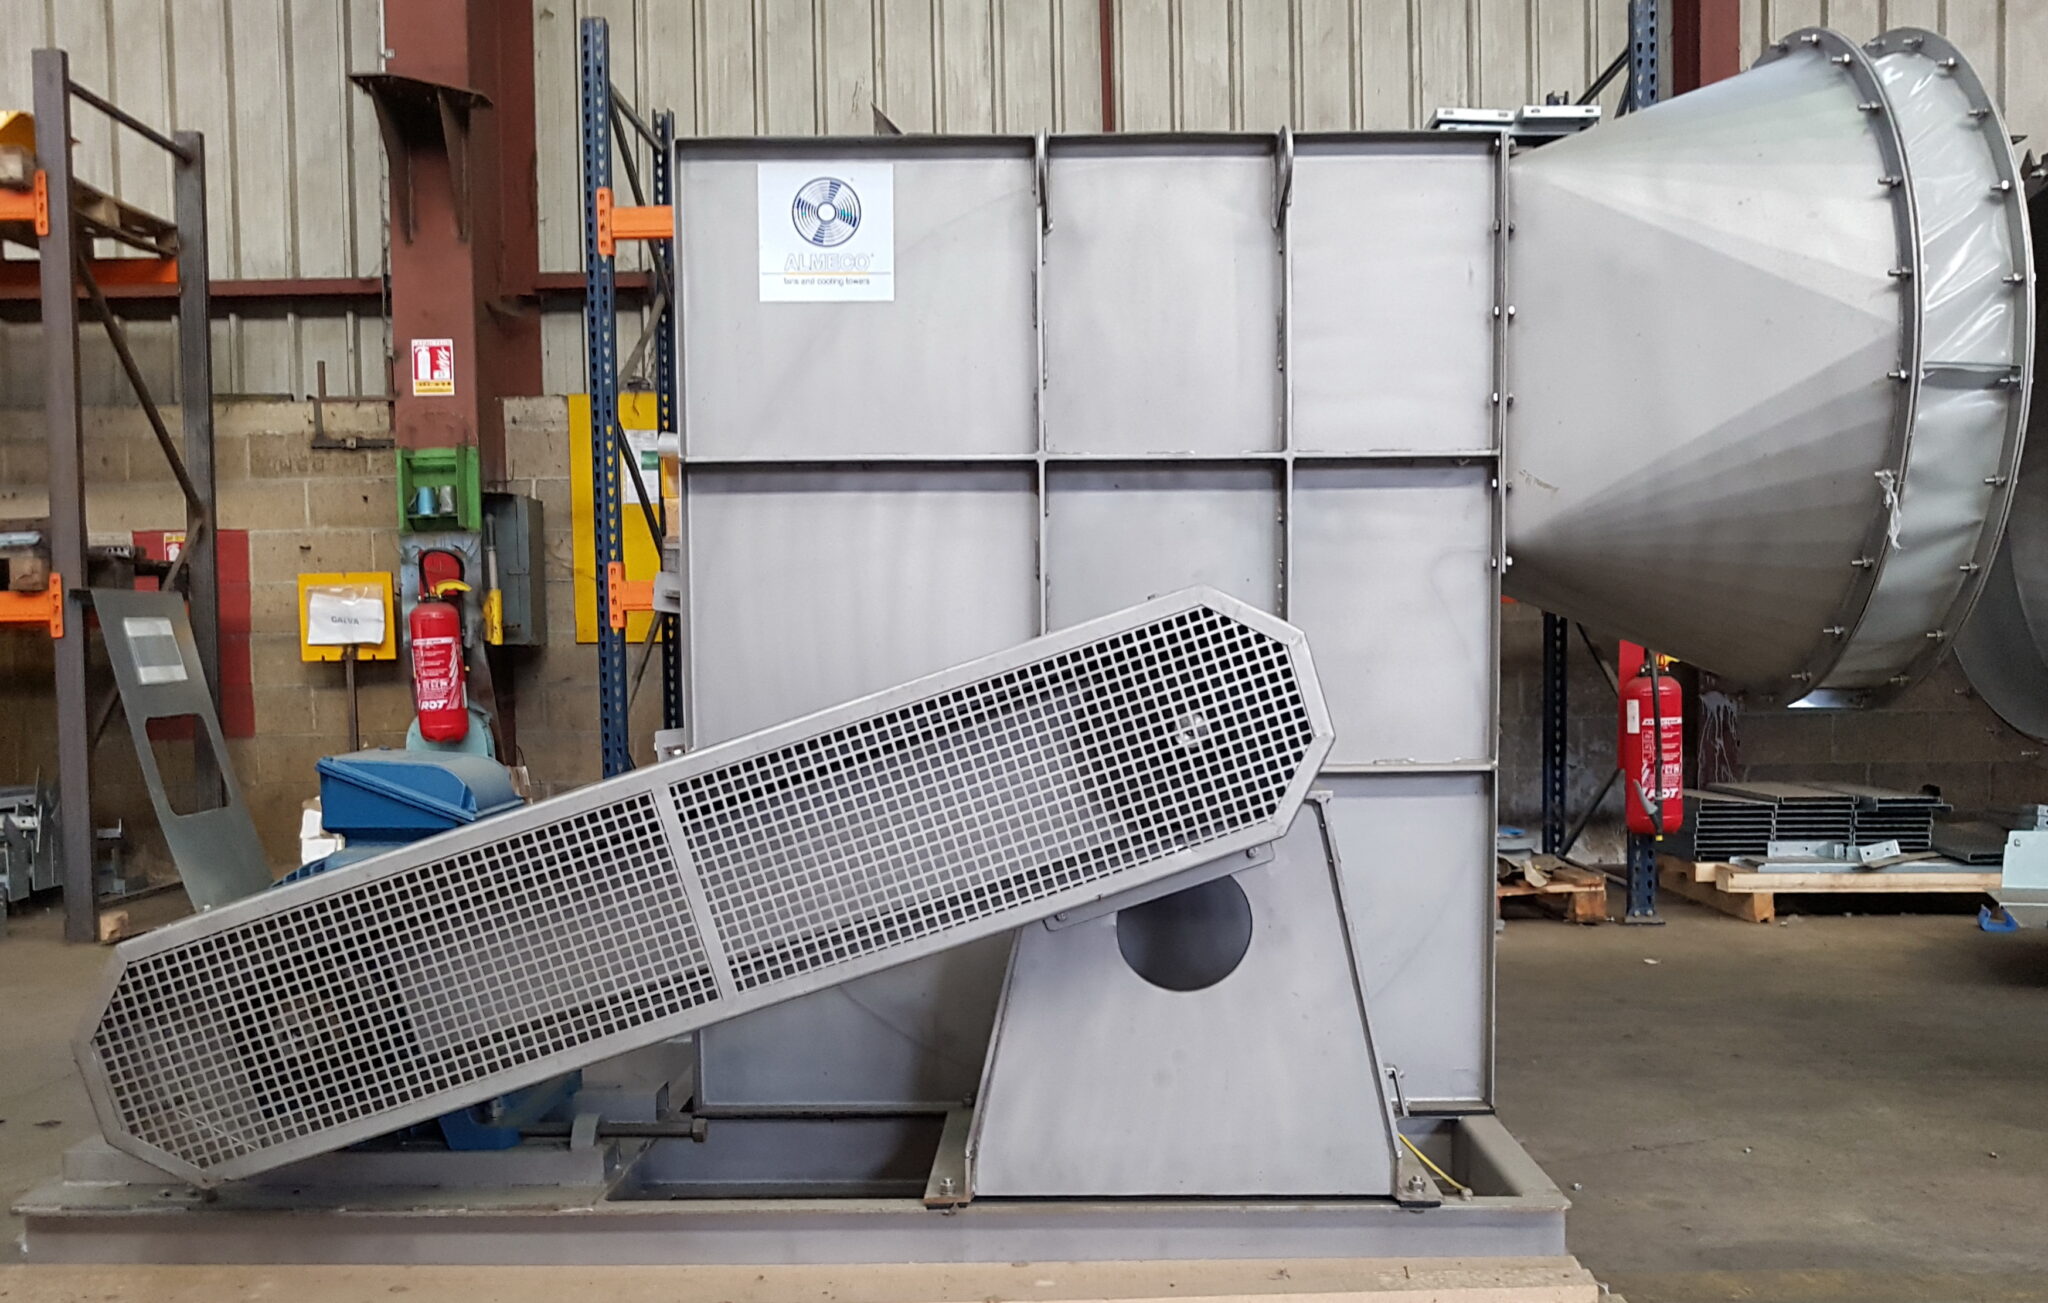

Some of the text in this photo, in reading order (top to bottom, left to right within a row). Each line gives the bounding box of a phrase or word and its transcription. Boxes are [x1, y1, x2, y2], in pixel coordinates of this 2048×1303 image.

[784, 252, 871, 271] ALMECO
[801, 277, 815, 285] and
[817, 277, 844, 287] cooling
[845, 277, 870, 285] towers
